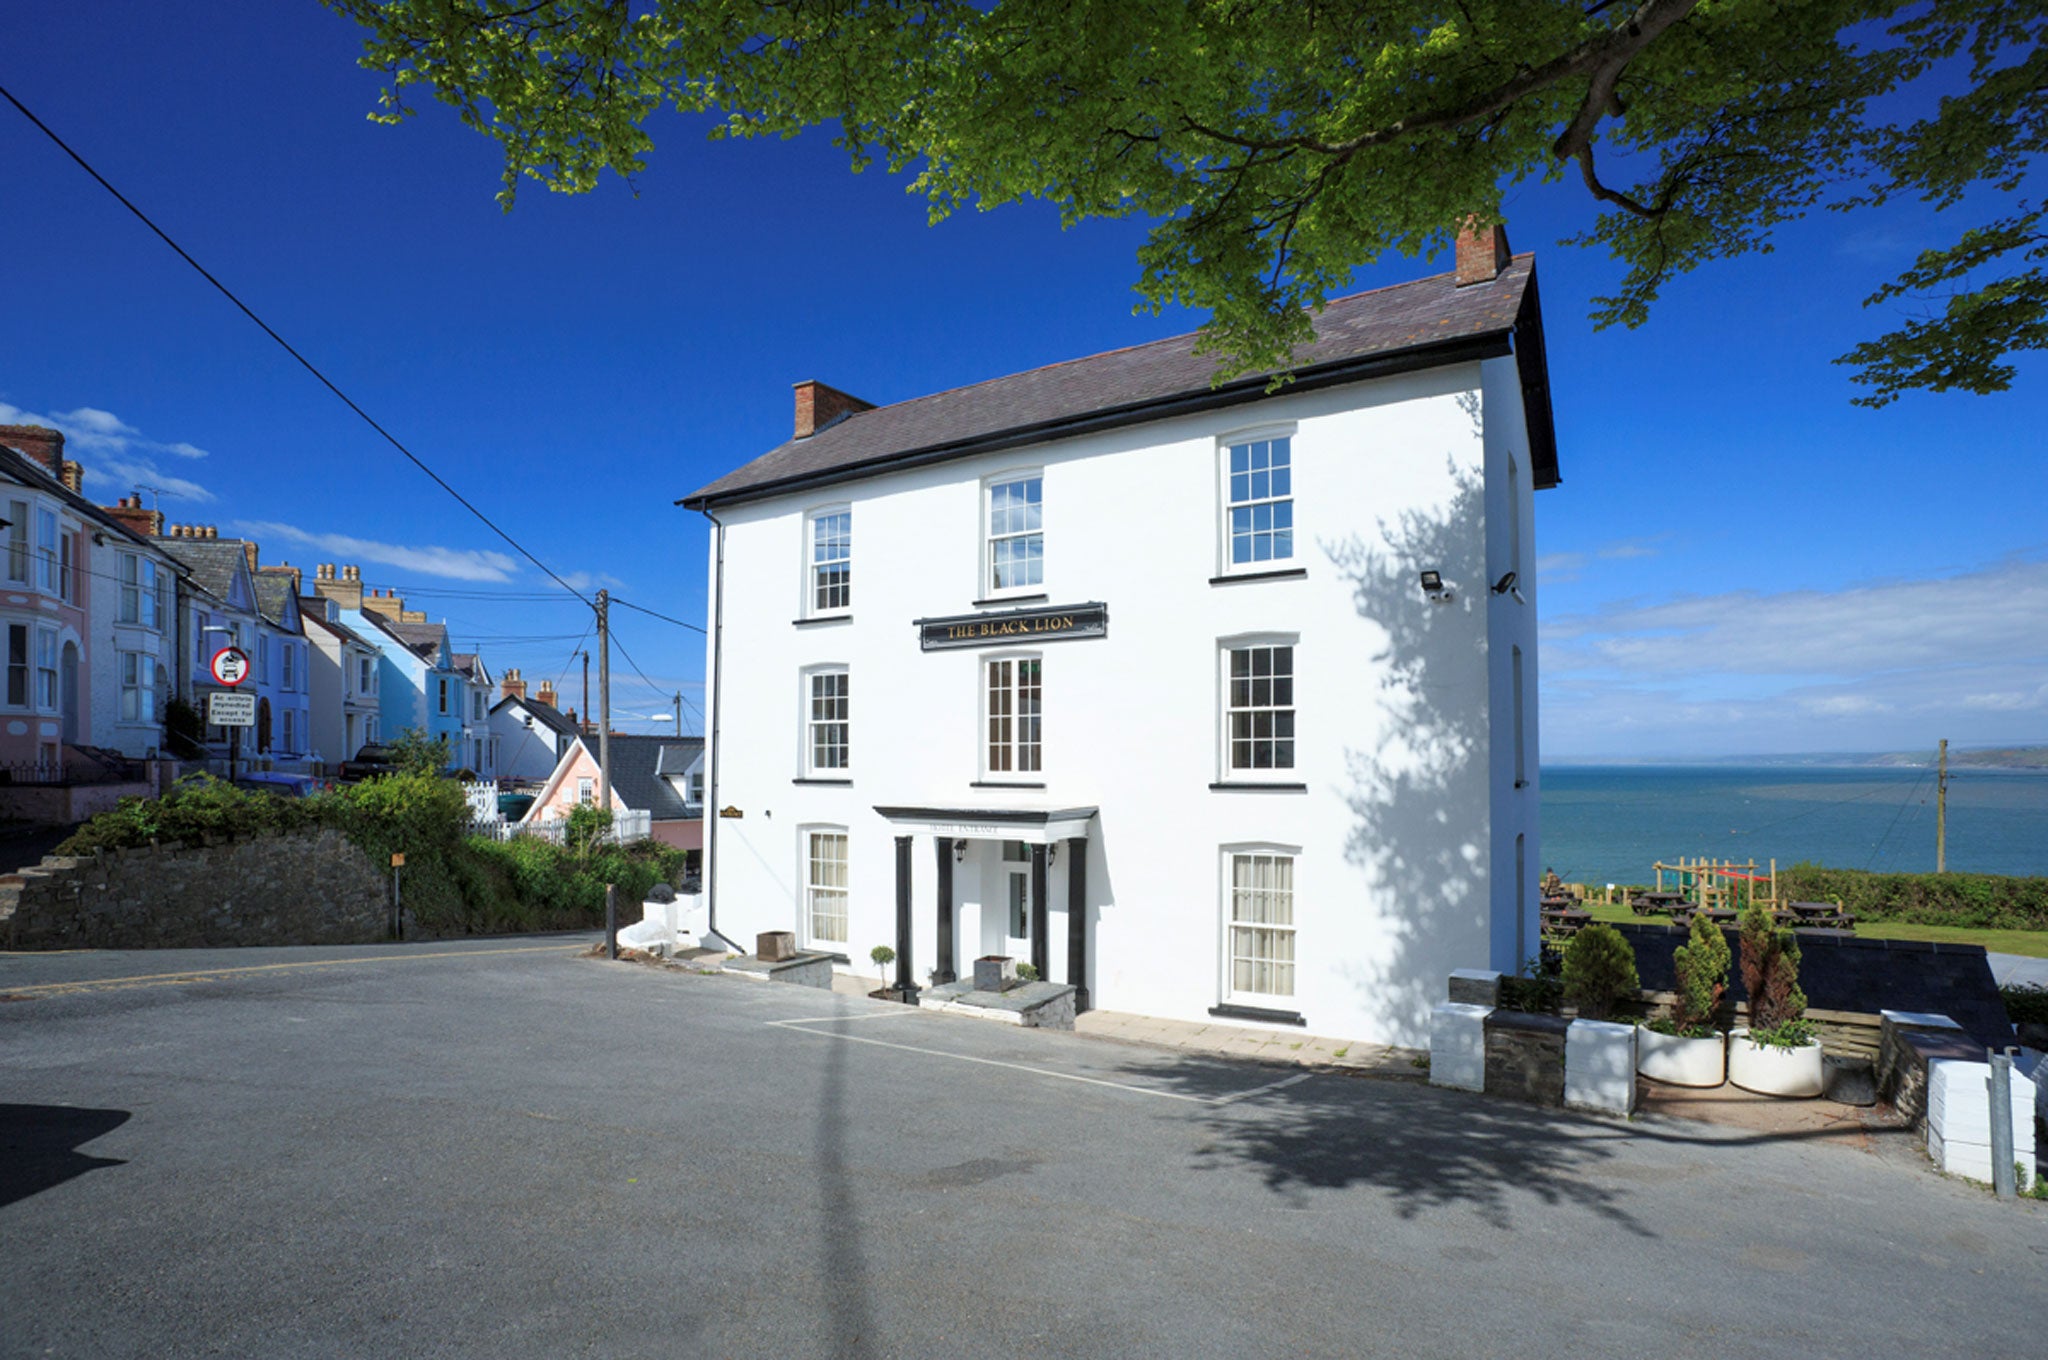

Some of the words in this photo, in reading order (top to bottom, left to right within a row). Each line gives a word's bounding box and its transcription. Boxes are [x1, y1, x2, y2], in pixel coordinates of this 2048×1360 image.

[948, 625, 975, 639] THE
[980, 620, 1028, 636] BLACK
[1035, 616, 1073, 631] LION
[211, 709, 238, 717] Except
